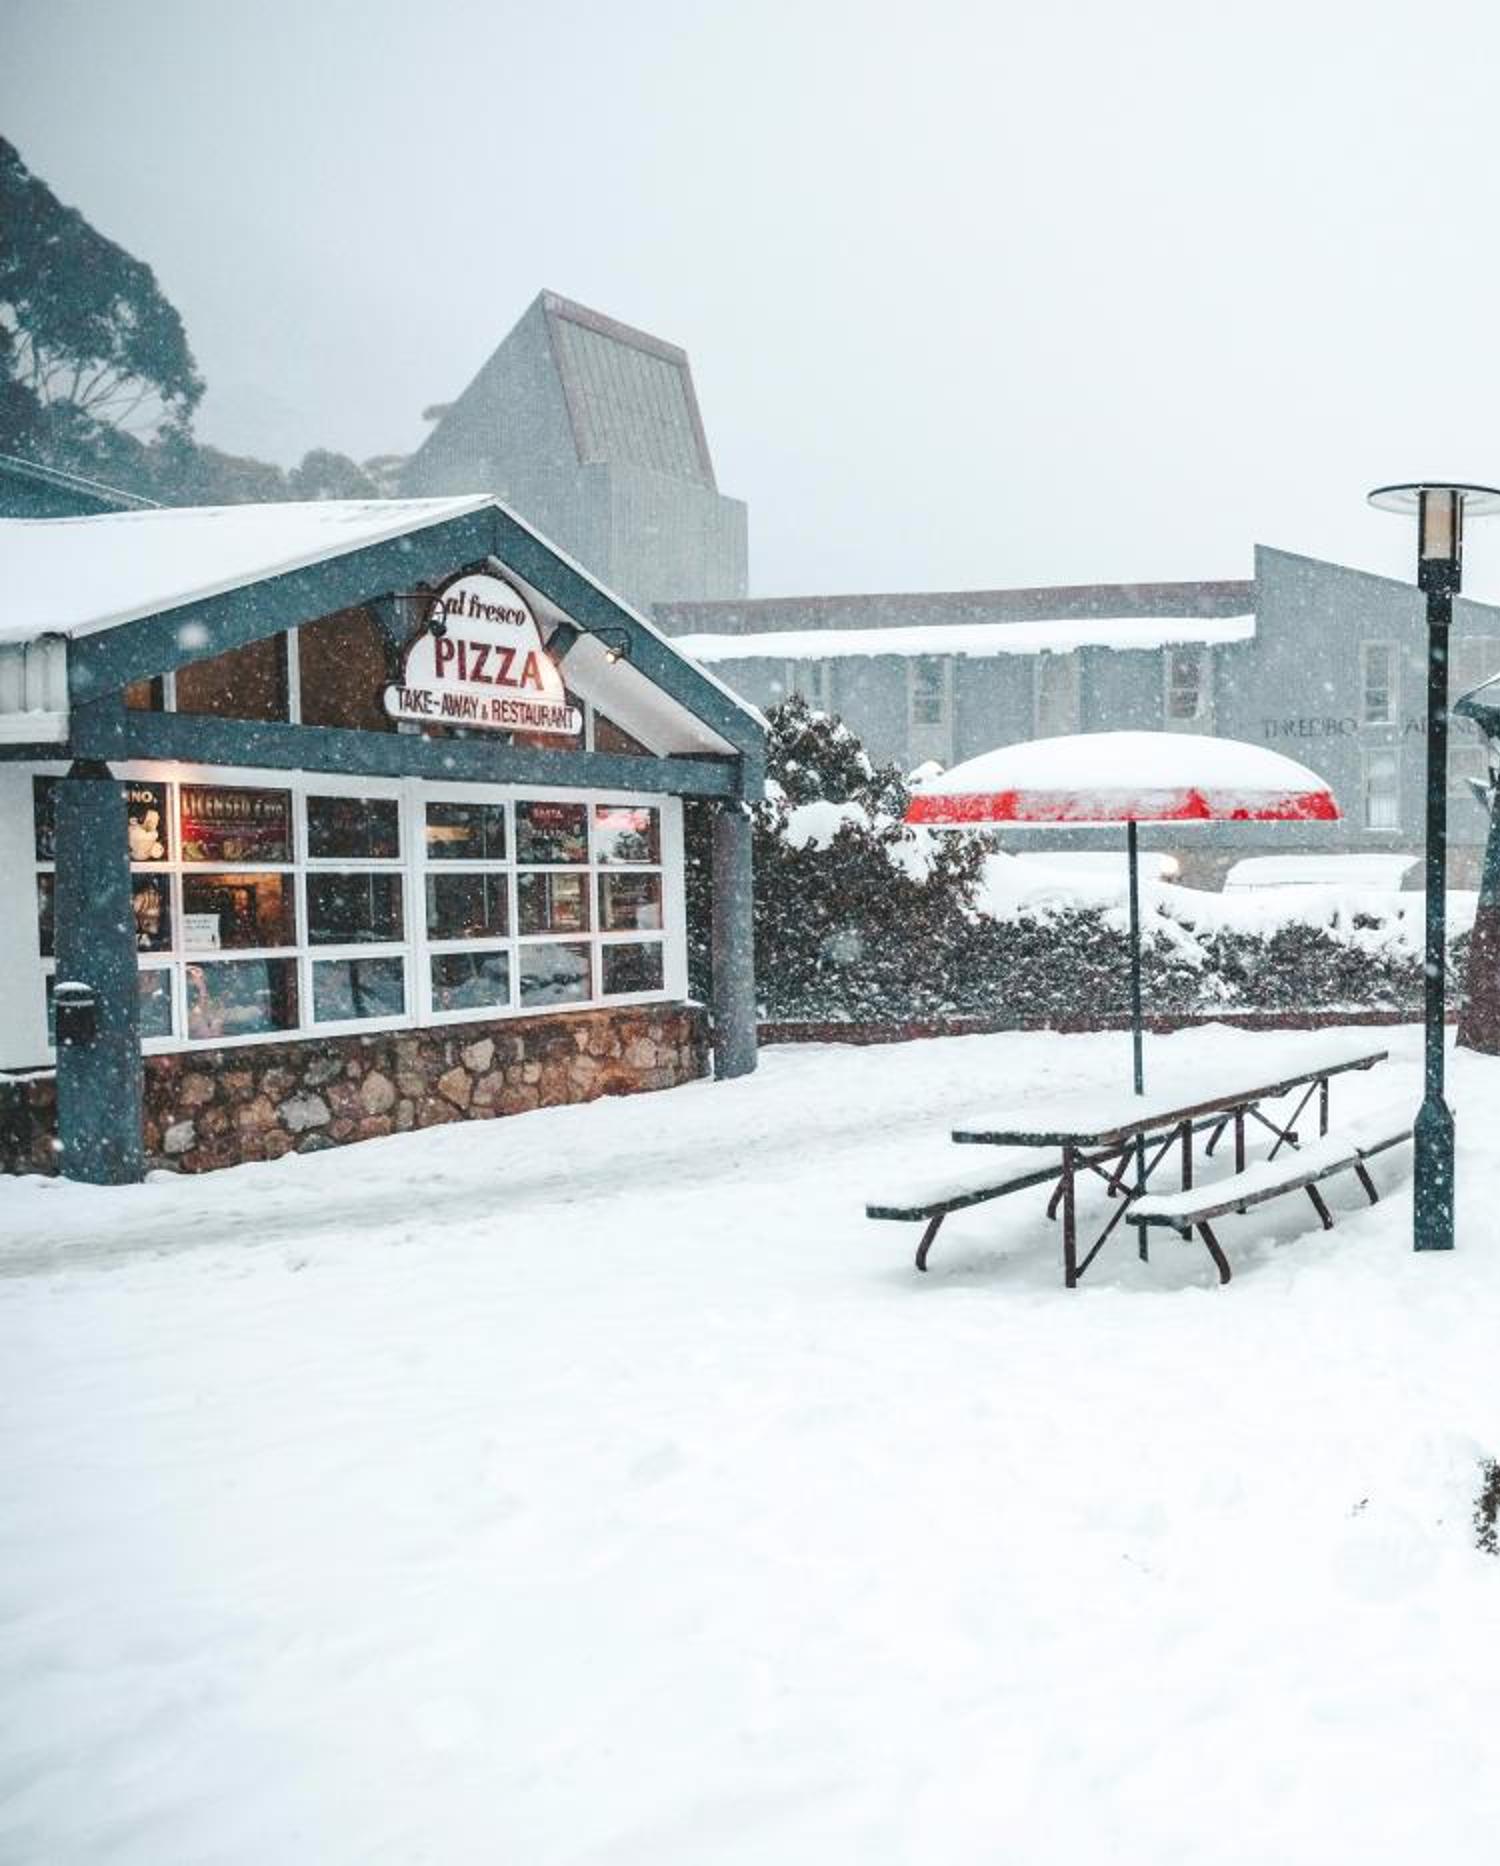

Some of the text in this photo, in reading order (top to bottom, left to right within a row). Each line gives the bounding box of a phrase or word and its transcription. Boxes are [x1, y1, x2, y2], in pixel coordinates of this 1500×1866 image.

[469, 594, 526, 626] fresco
[434, 638, 544, 691] PIZZA
[396, 686, 479, 720] TAKE-AWAY
[491, 699, 576, 730] RESTAURANT
